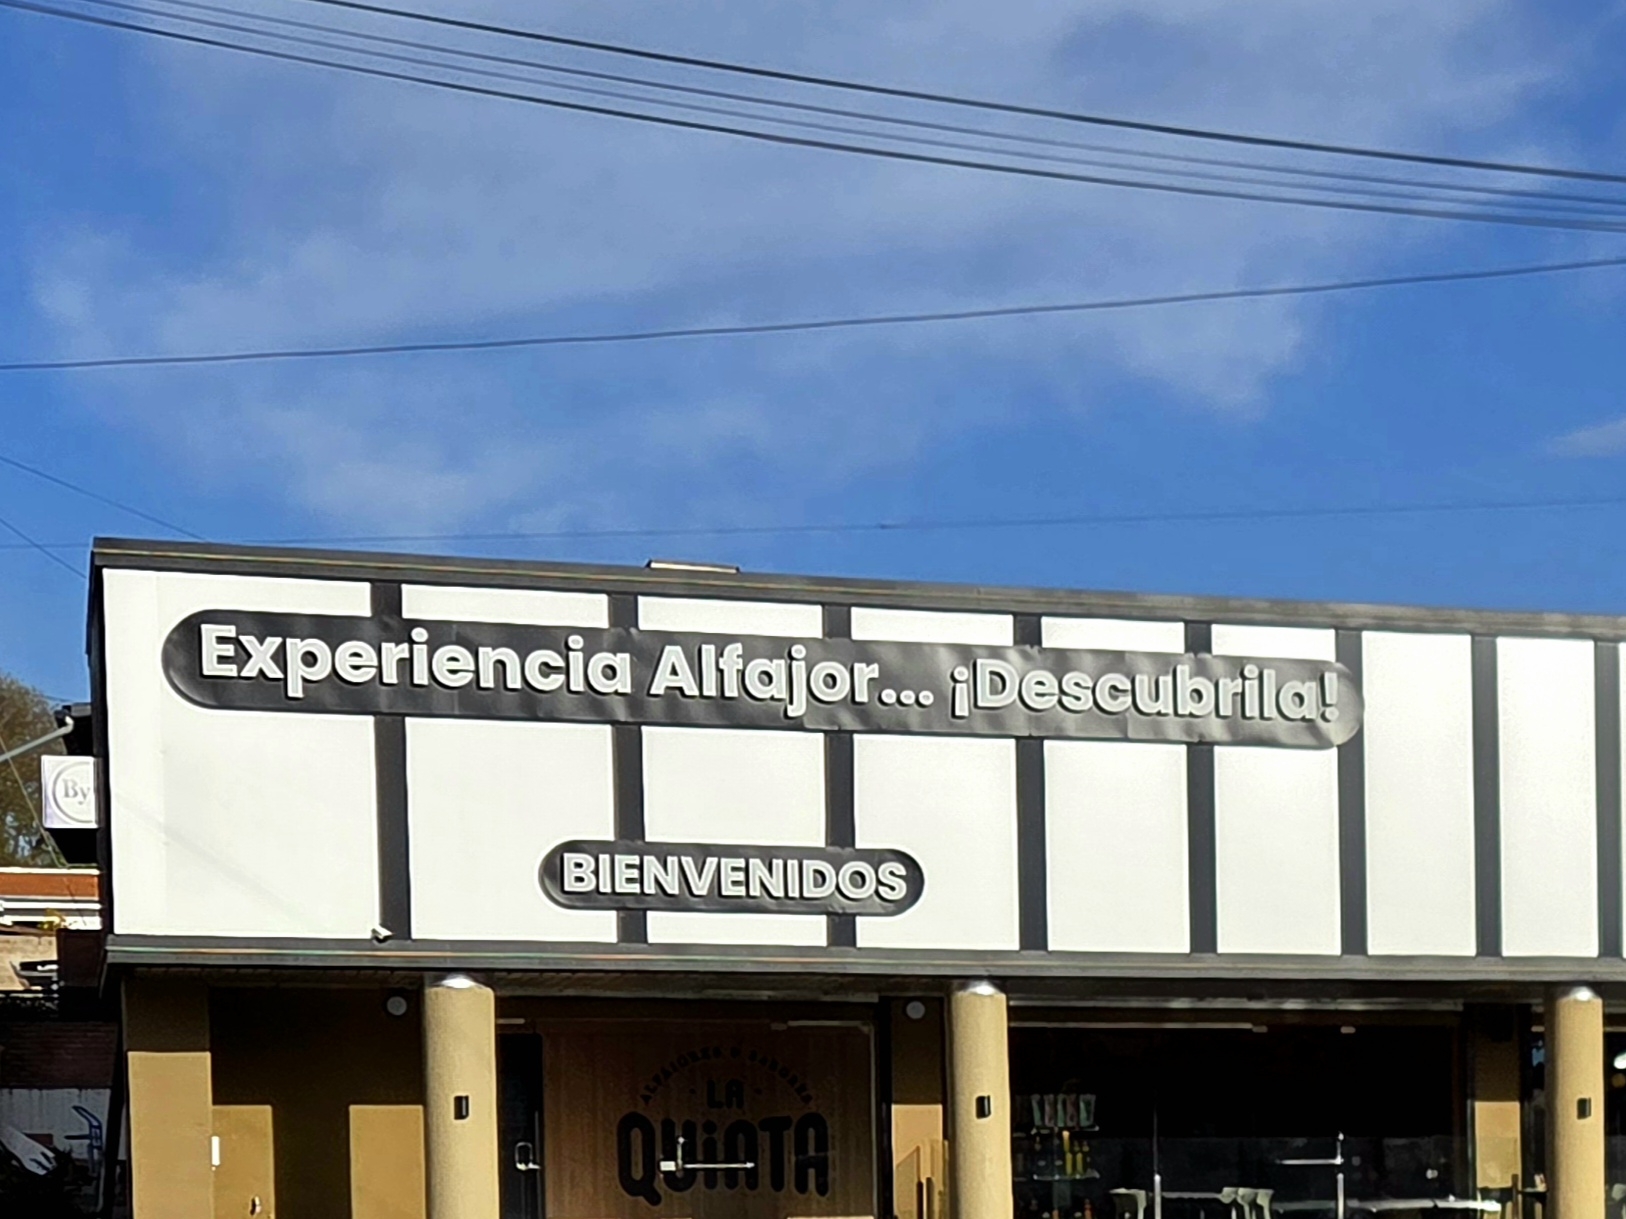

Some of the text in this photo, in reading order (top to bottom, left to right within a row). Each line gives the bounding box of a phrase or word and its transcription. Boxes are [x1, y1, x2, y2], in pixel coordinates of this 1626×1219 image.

[200, 623, 1341, 721] Experiencia Alfajor... ¡Descubrila!
[562, 852, 908, 900] BIENVENIDOS
[706, 1078, 745, 1109] LA
